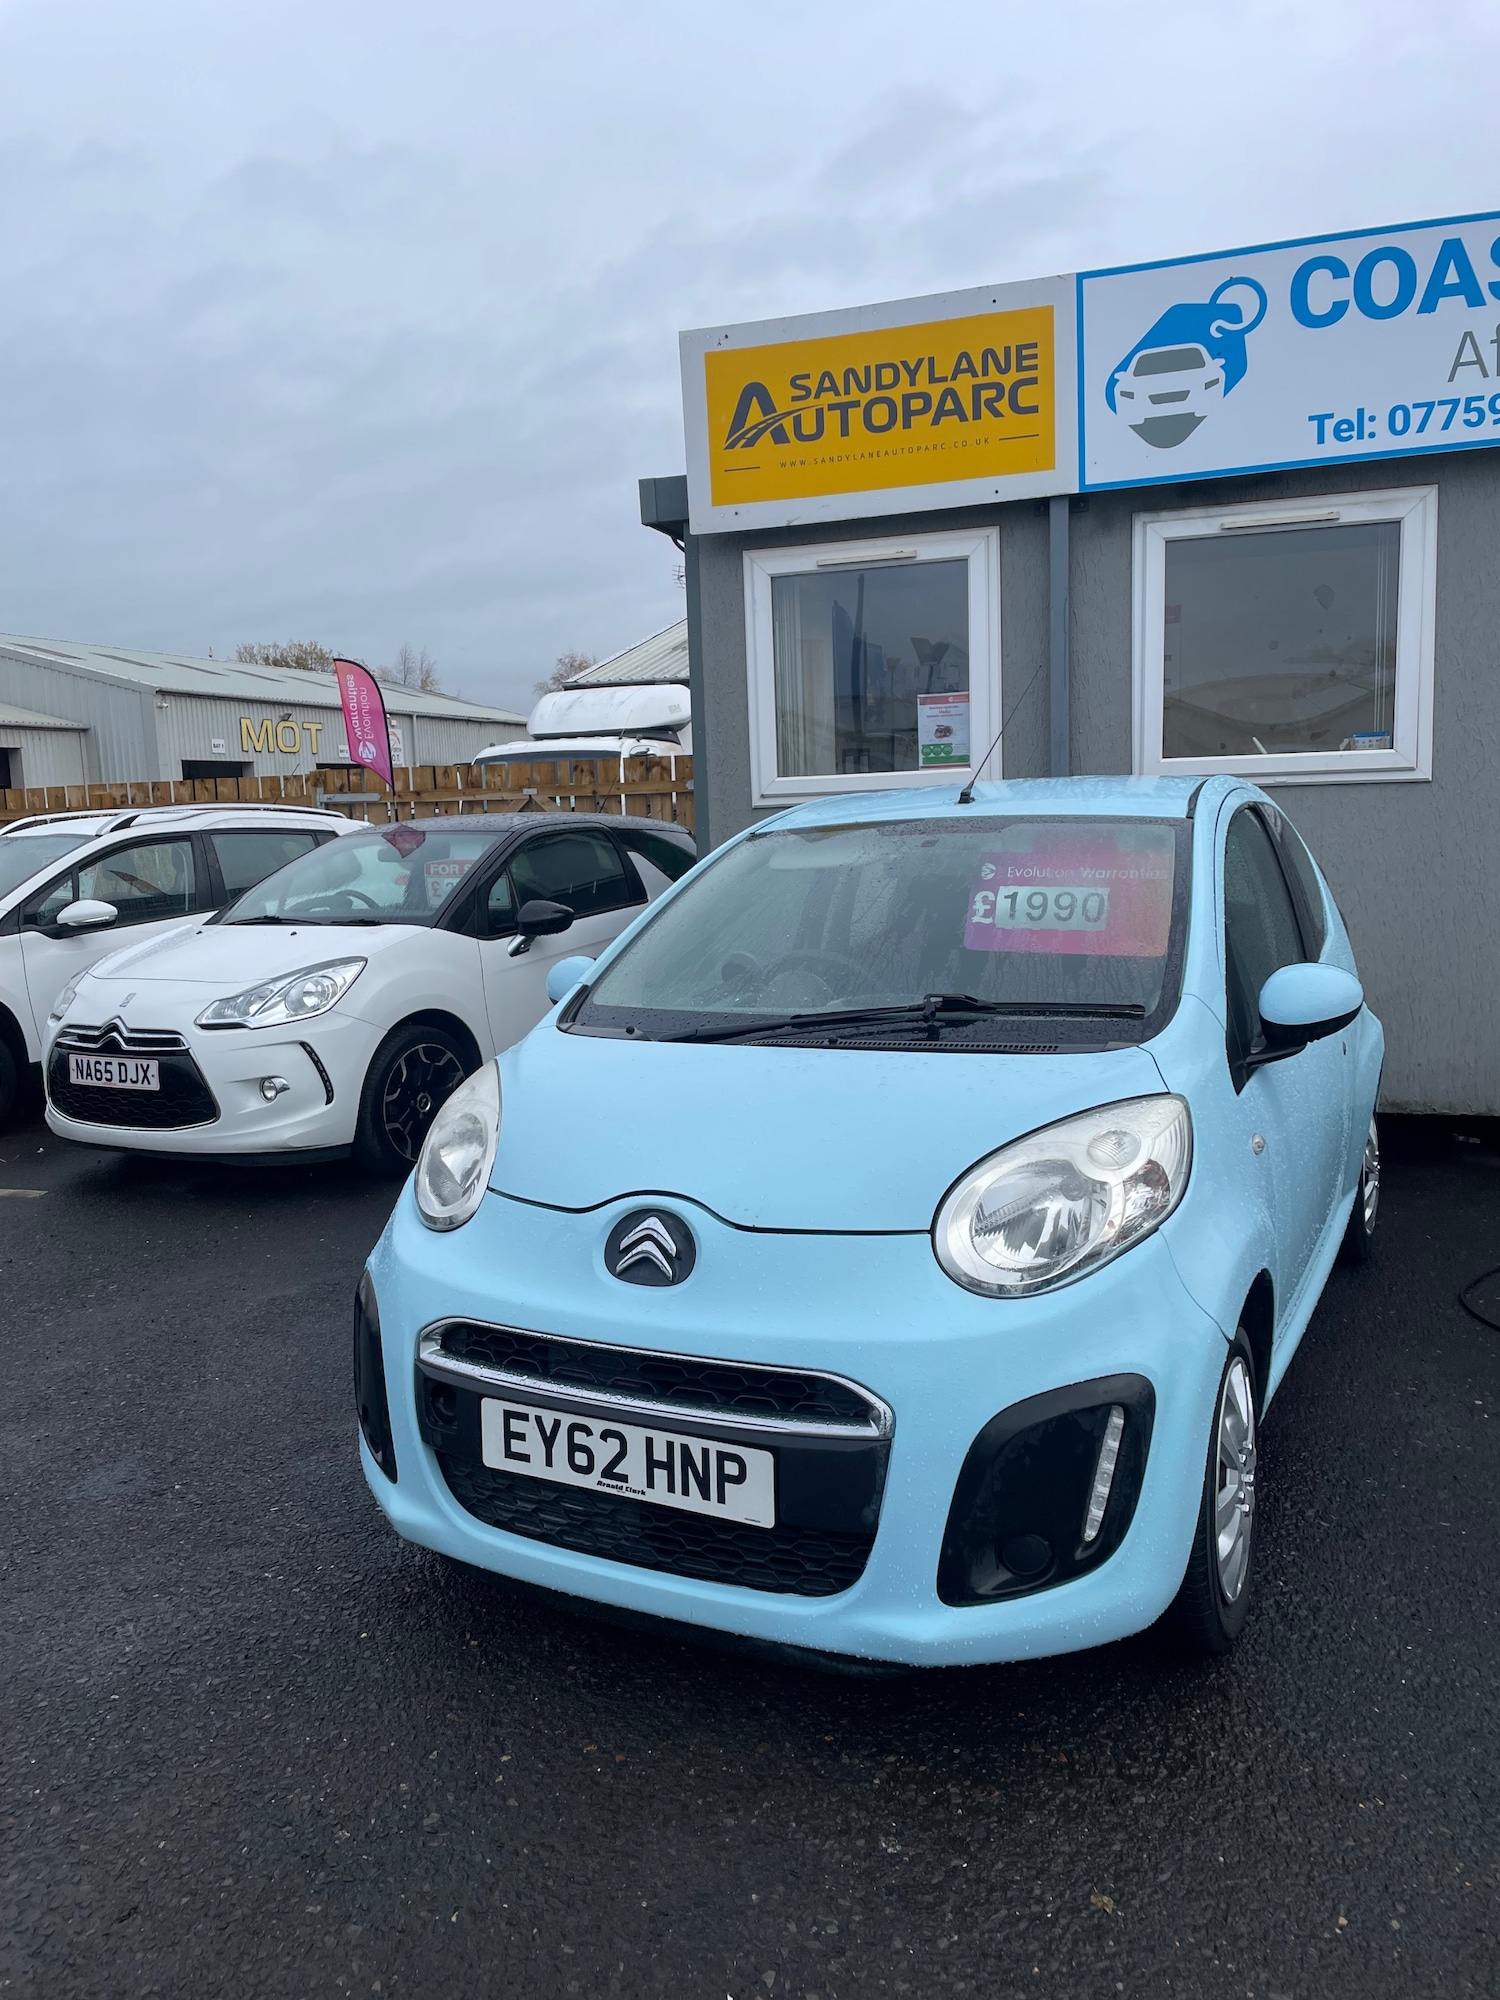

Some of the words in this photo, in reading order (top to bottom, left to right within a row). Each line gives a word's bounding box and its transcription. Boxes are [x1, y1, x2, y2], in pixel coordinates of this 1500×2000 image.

[1289, 236, 1500, 329] COA
[789, 341, 1039, 402] SANDYLANE
[723, 376, 1040, 451] AUTOPARC
[1308, 406, 1377, 445] Tel:
[779, 436, 990, 469] WWW.SANDYLANEAUTOPARC.CO.UK
[239, 717, 323, 755] MOT
[430, 863, 460, 875] FOR
[75, 1058, 113, 1083] NA65
[117, 1062, 151, 1086] DJX
[503, 1408, 629, 1484] EY62
[644, 1435, 747, 1505] HNP
